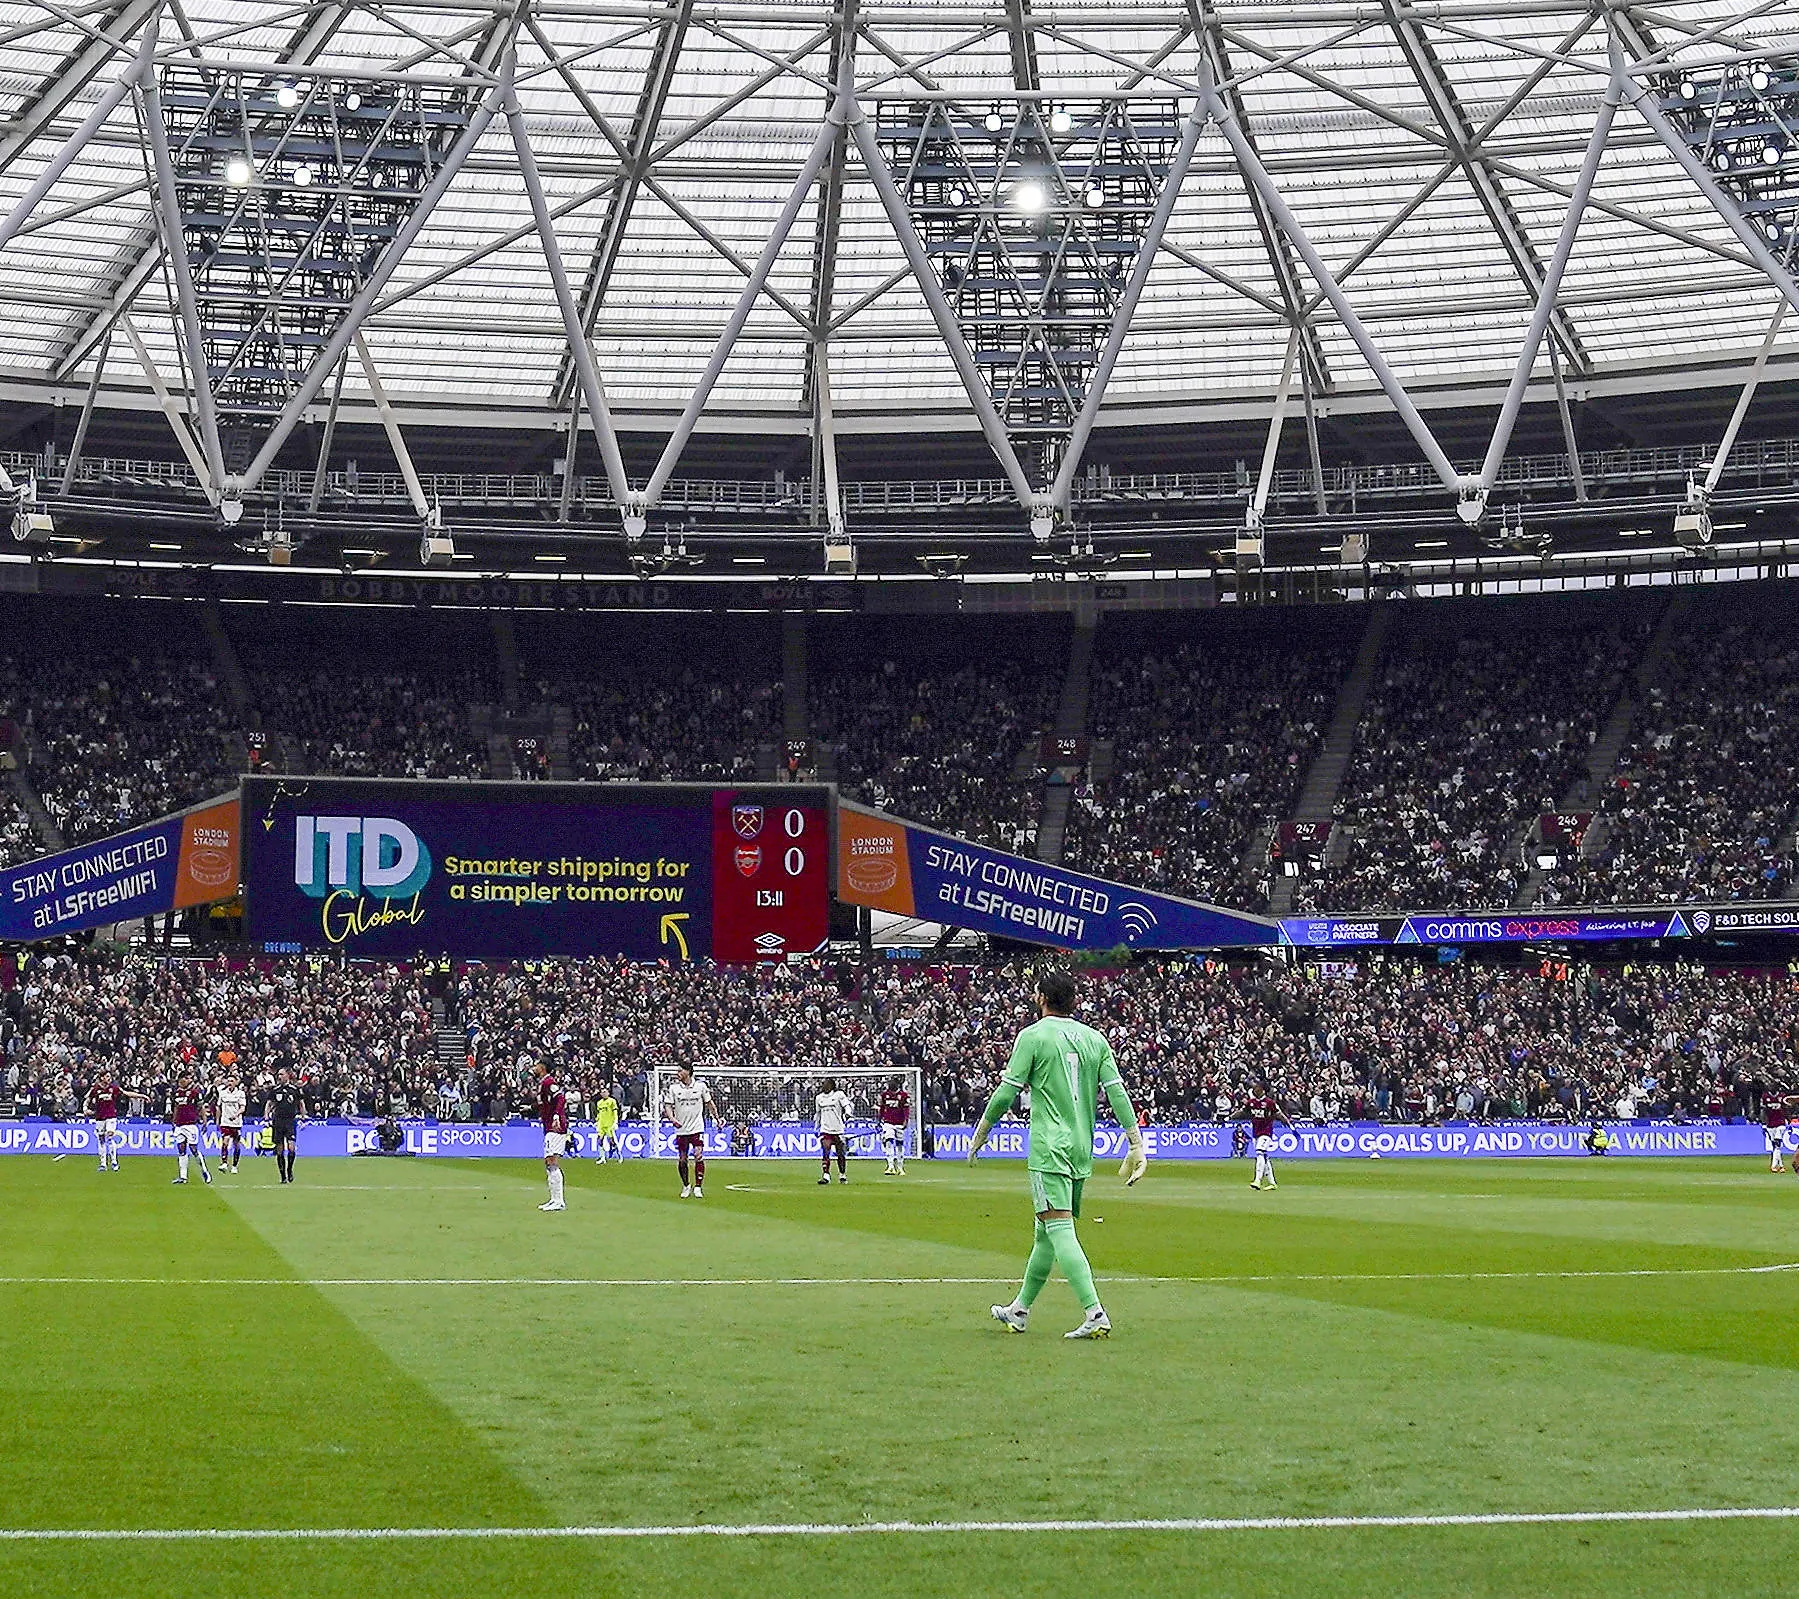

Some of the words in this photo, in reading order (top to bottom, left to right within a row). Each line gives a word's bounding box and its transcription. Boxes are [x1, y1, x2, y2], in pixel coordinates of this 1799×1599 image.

[249, 732, 265, 742] 251
[787, 740, 805, 750] 249
[784, 809, 804, 838] 0
[1296, 822, 1317, 834] 247
[1557, 814, 1577, 826] 246
[193, 828, 229, 838] LONDON
[193, 837, 229, 848] STADIUM
[851, 837, 894, 846] LONDON
[295, 816, 424, 889] ITD
[784, 847, 805, 876] 0
[851, 846, 894, 855] STADIUM
[12, 868, 60, 902] STAY
[62, 835, 168, 888] CONNECTED
[444, 856, 543, 876] Smarter
[547, 856, 651, 883] shipping
[656, 857, 690, 878] for
[926, 845, 980, 878] STAY
[981, 861, 1109, 916] CONNECTED
[34, 906, 53, 929] at
[55, 869, 157, 921] LSFreeWIFI
[450, 885, 465, 900] a
[470, 880, 562, 906] simpler
[566, 883, 685, 902] tomorrow
[322, 889, 425, 944] Global
[938, 881, 961, 904] at
[963, 886, 1085, 941] LSFreeWIFI
[1715, 914, 1739, 926] F&D
[1741, 913, 1770, 926] TECH
[1332, 923, 1380, 932] ASSOCIATE
[1332, 931, 1379, 940] PARTNERS
[1426, 920, 1502, 940] comms
[1506, 920, 1580, 939] express
[756, 947, 783, 955] umbro
[1066, 1052, 1080, 1102] 1
[34, 1129, 89, 1149] AND
[116, 1130, 175, 1149] OU'RE
[347, 1129, 438, 1153] BOLE
[441, 1130, 502, 1146] SPORTS
[1092, 1135, 1158, 1155] OYE
[1161, 1131, 1219, 1147] SPORTS
[1300, 1133, 1355, 1152] TWO
[1358, 1132, 1434, 1152] GOALS
[1437, 1133, 1470, 1155] UP,
[1473, 1132, 1523, 1151] AND
[1526, 1131, 1588, 1150] YOU'R
[1608, 1132, 1620, 1150] A
[1626, 1131, 1717, 1150] WINNER
